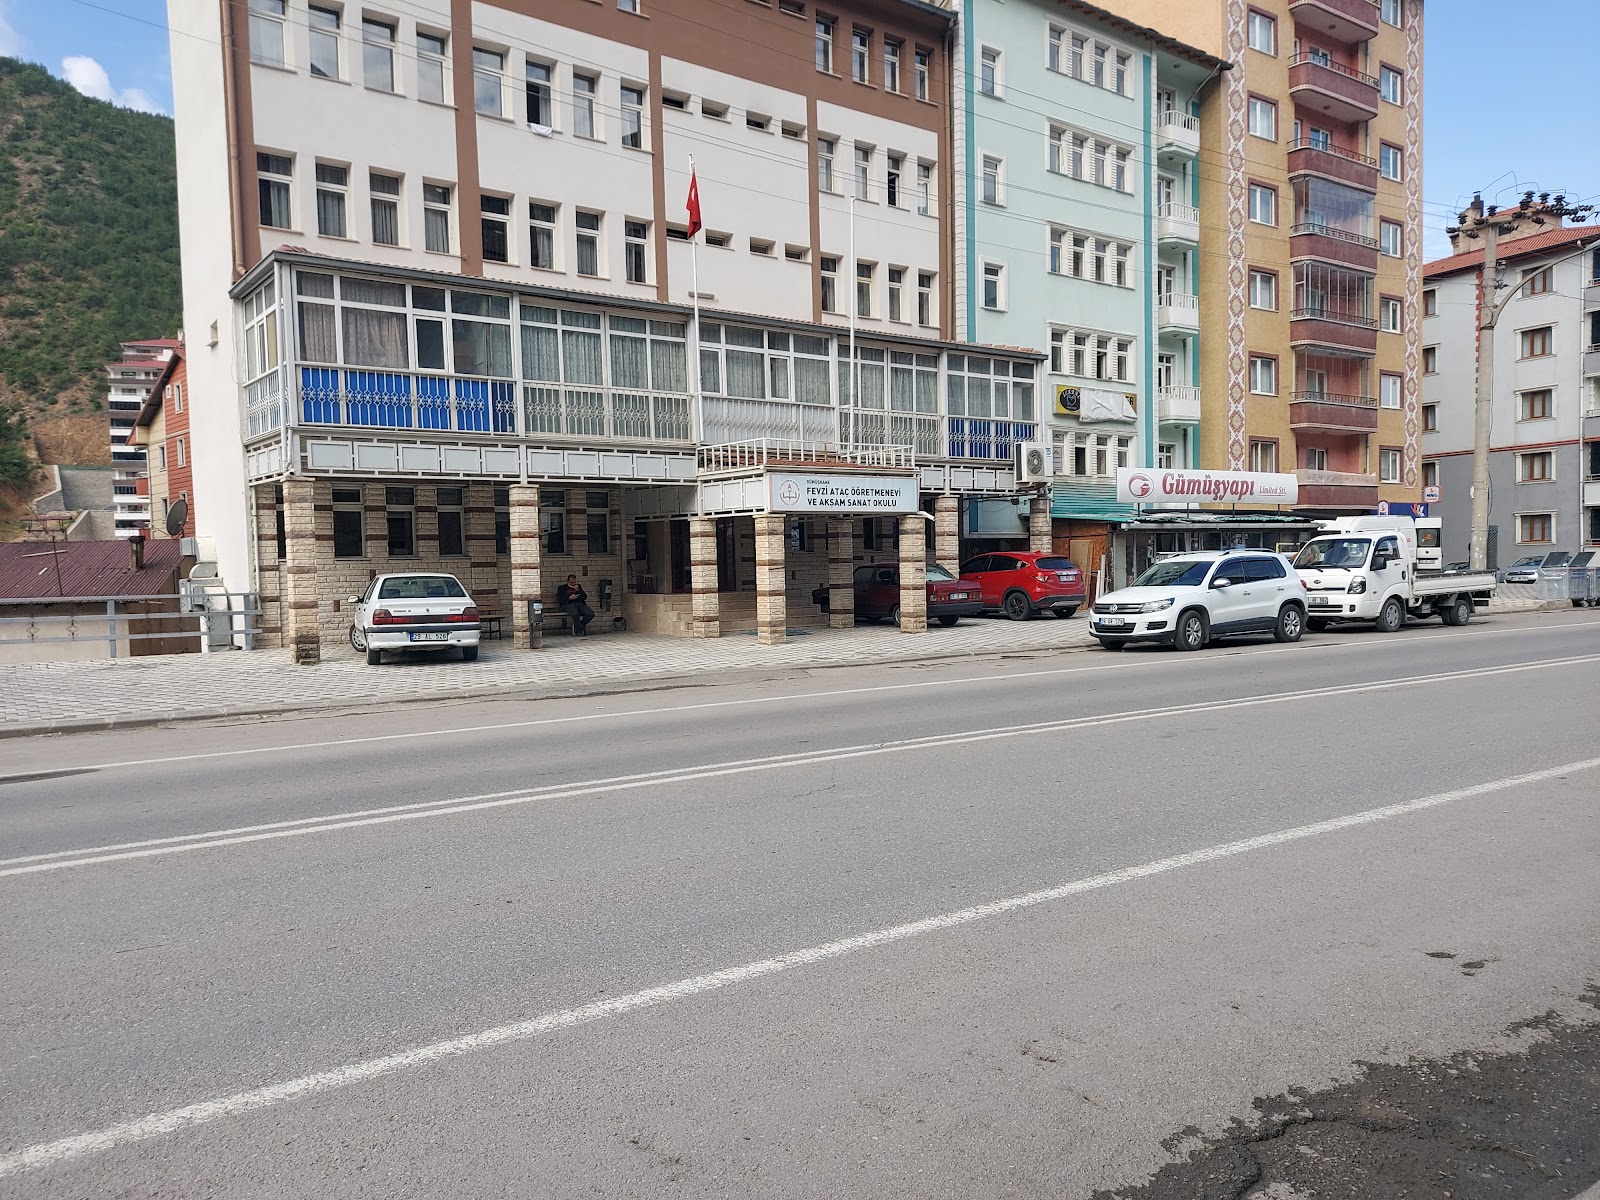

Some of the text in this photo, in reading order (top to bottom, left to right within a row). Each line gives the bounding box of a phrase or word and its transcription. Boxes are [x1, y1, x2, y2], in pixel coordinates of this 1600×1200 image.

[806, 485, 901, 498] FEVZİ ATAÇ ÖĞRETMENEVİ
[1162, 472, 1254, 500] Gümüşyapı
[1259, 485, 1278, 495] Limited
[807, 498, 818, 506] VE
[819, 498, 846, 508] AKŞAM
[847, 499, 871, 507] SANAT
